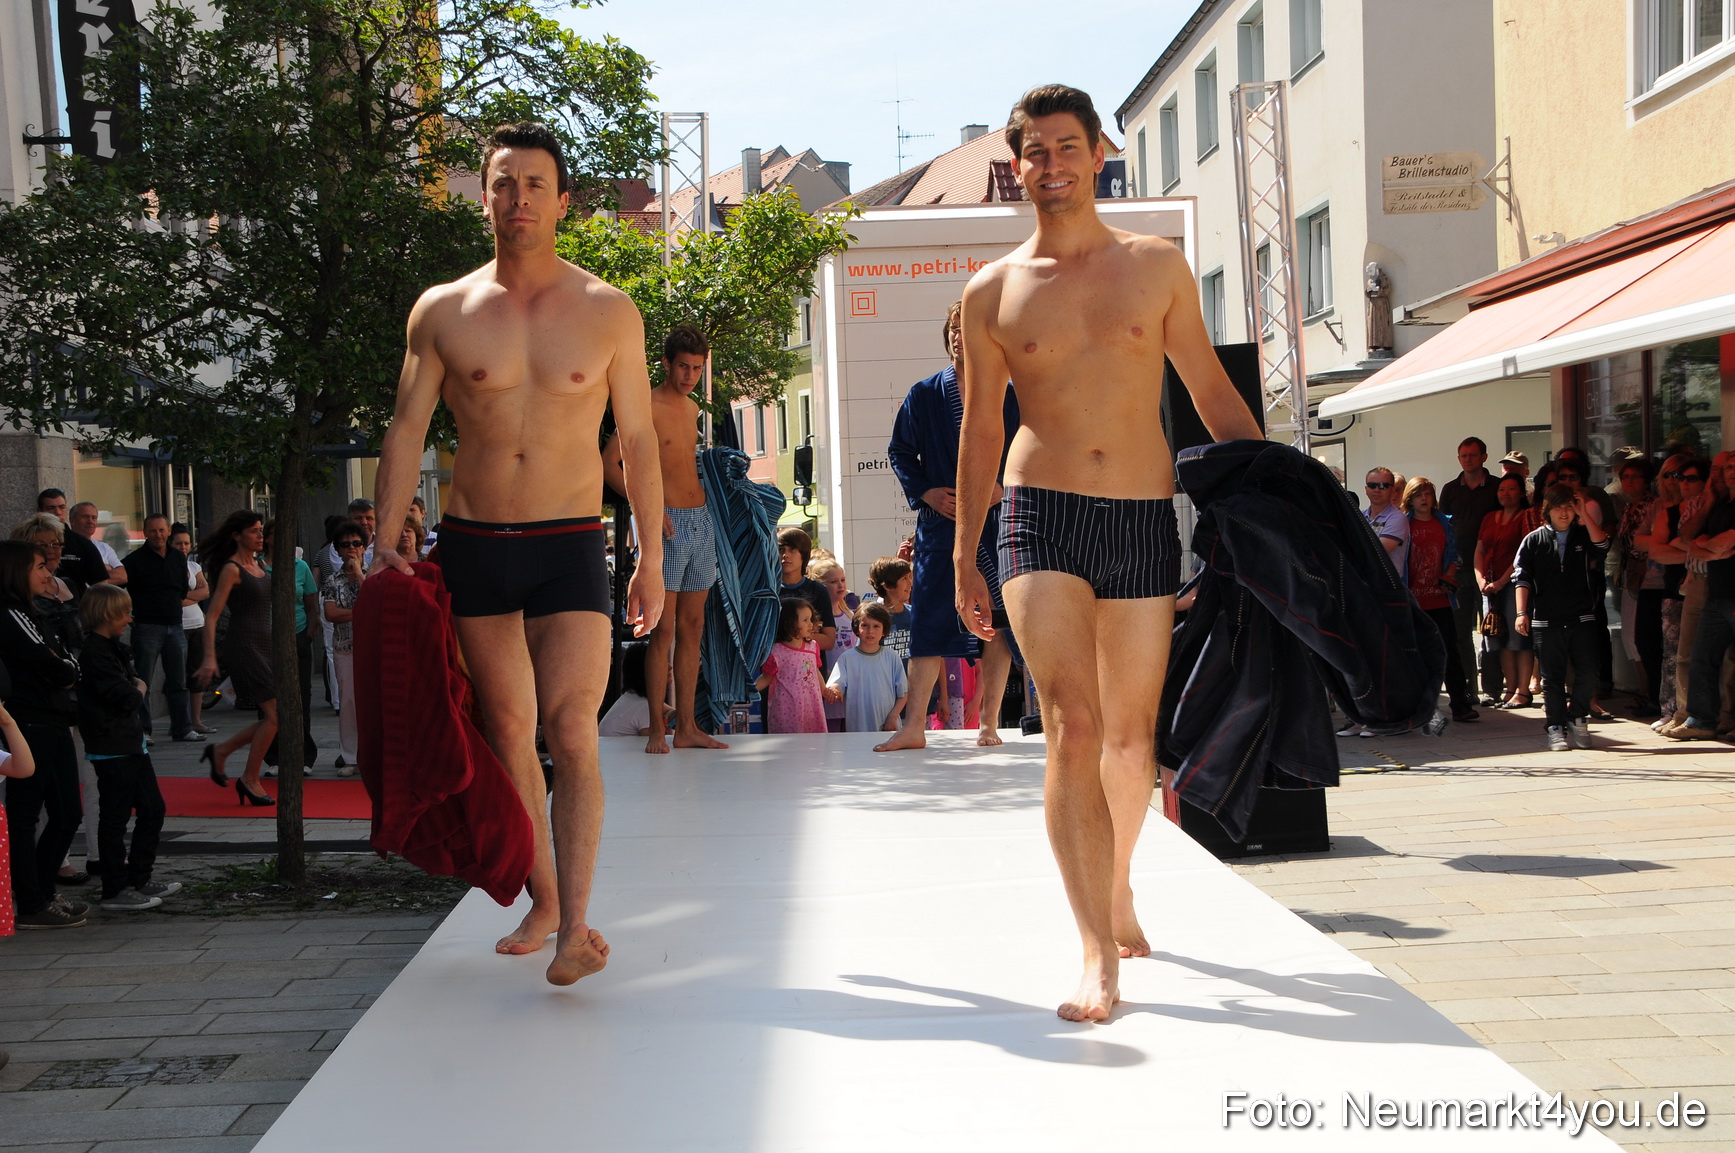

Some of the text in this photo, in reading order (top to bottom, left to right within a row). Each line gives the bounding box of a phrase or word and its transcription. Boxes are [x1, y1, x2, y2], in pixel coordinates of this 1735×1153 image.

[1389, 155, 1434, 168] Bauer's
[1397, 165, 1469, 179] Brillenstudio
[1458, 189, 1467, 198] &
[857, 457, 888, 473] petri
